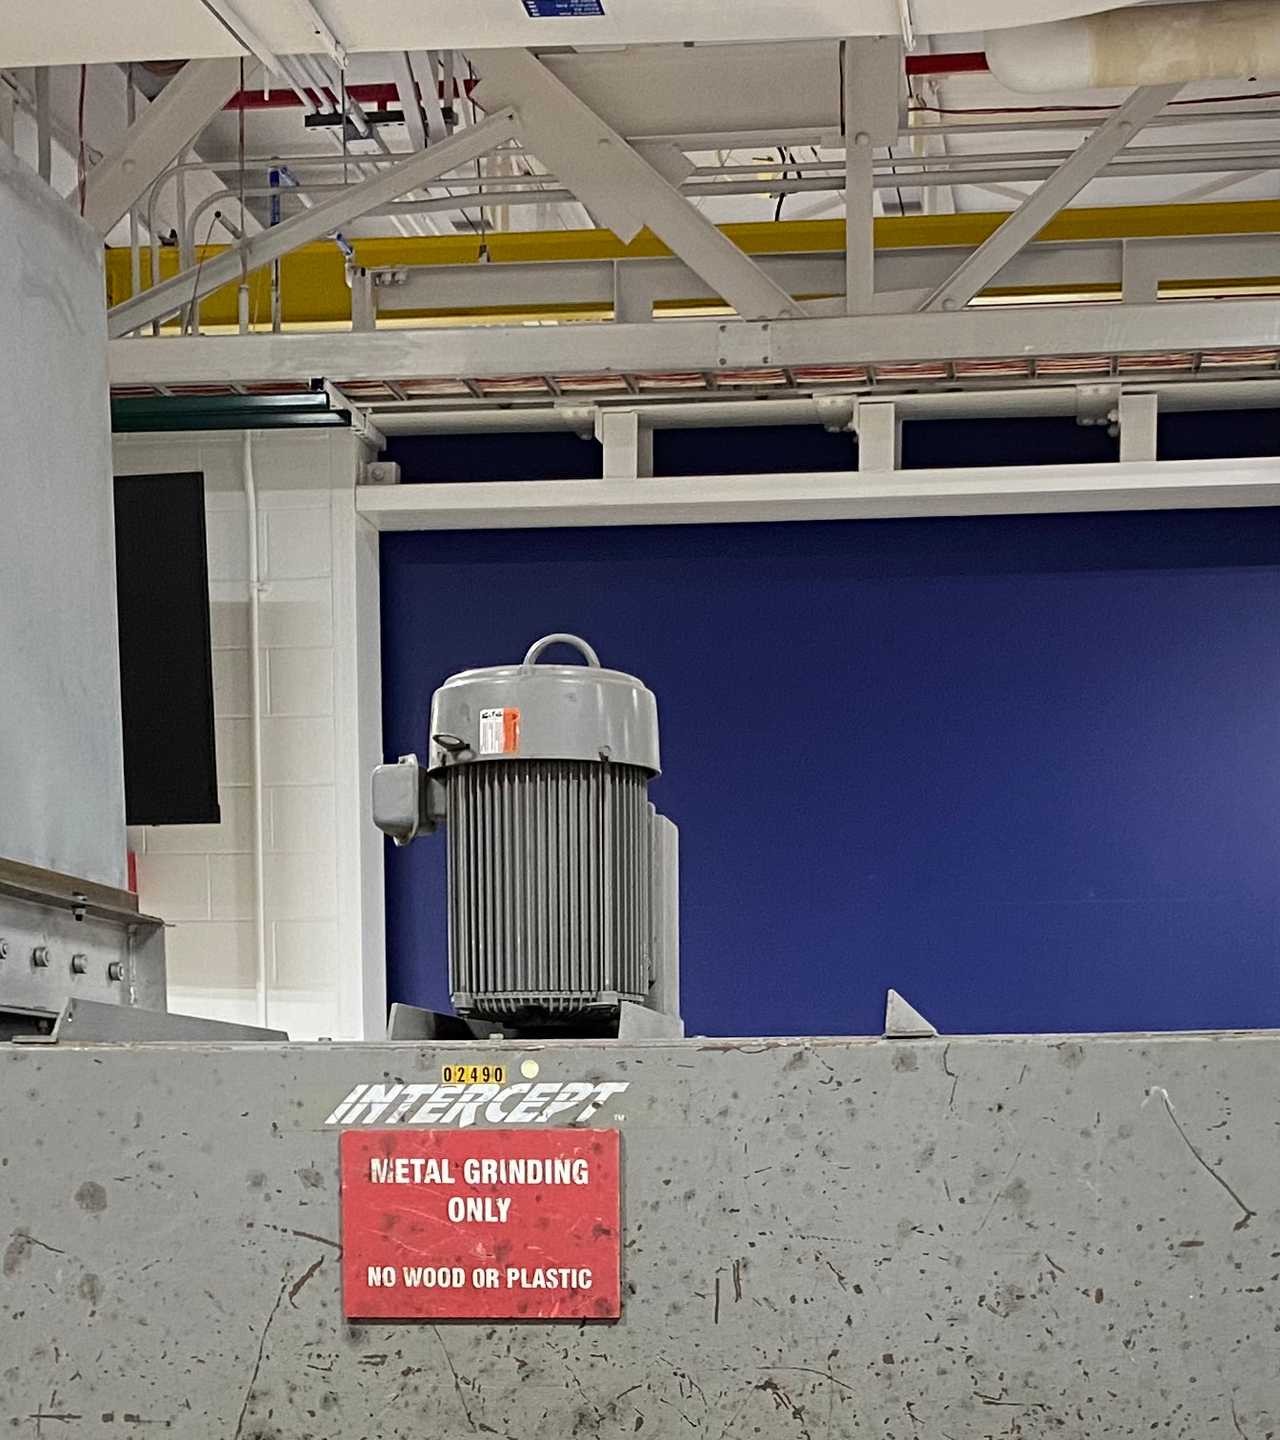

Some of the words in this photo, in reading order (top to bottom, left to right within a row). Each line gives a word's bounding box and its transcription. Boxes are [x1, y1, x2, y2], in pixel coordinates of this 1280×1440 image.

[443, 1067, 504, 1083] 02490
[325, 1081, 630, 1127] INTERCEPT
[370, 1158, 456, 1185] METAL
[463, 1159, 590, 1185] GRINDING
[447, 1197, 512, 1223] ONLY
[367, 1266, 396, 1287] NO
[403, 1267, 466, 1288] WOOD
[472, 1267, 500, 1289] OR
[507, 1268, 593, 1290] PLASTIC
